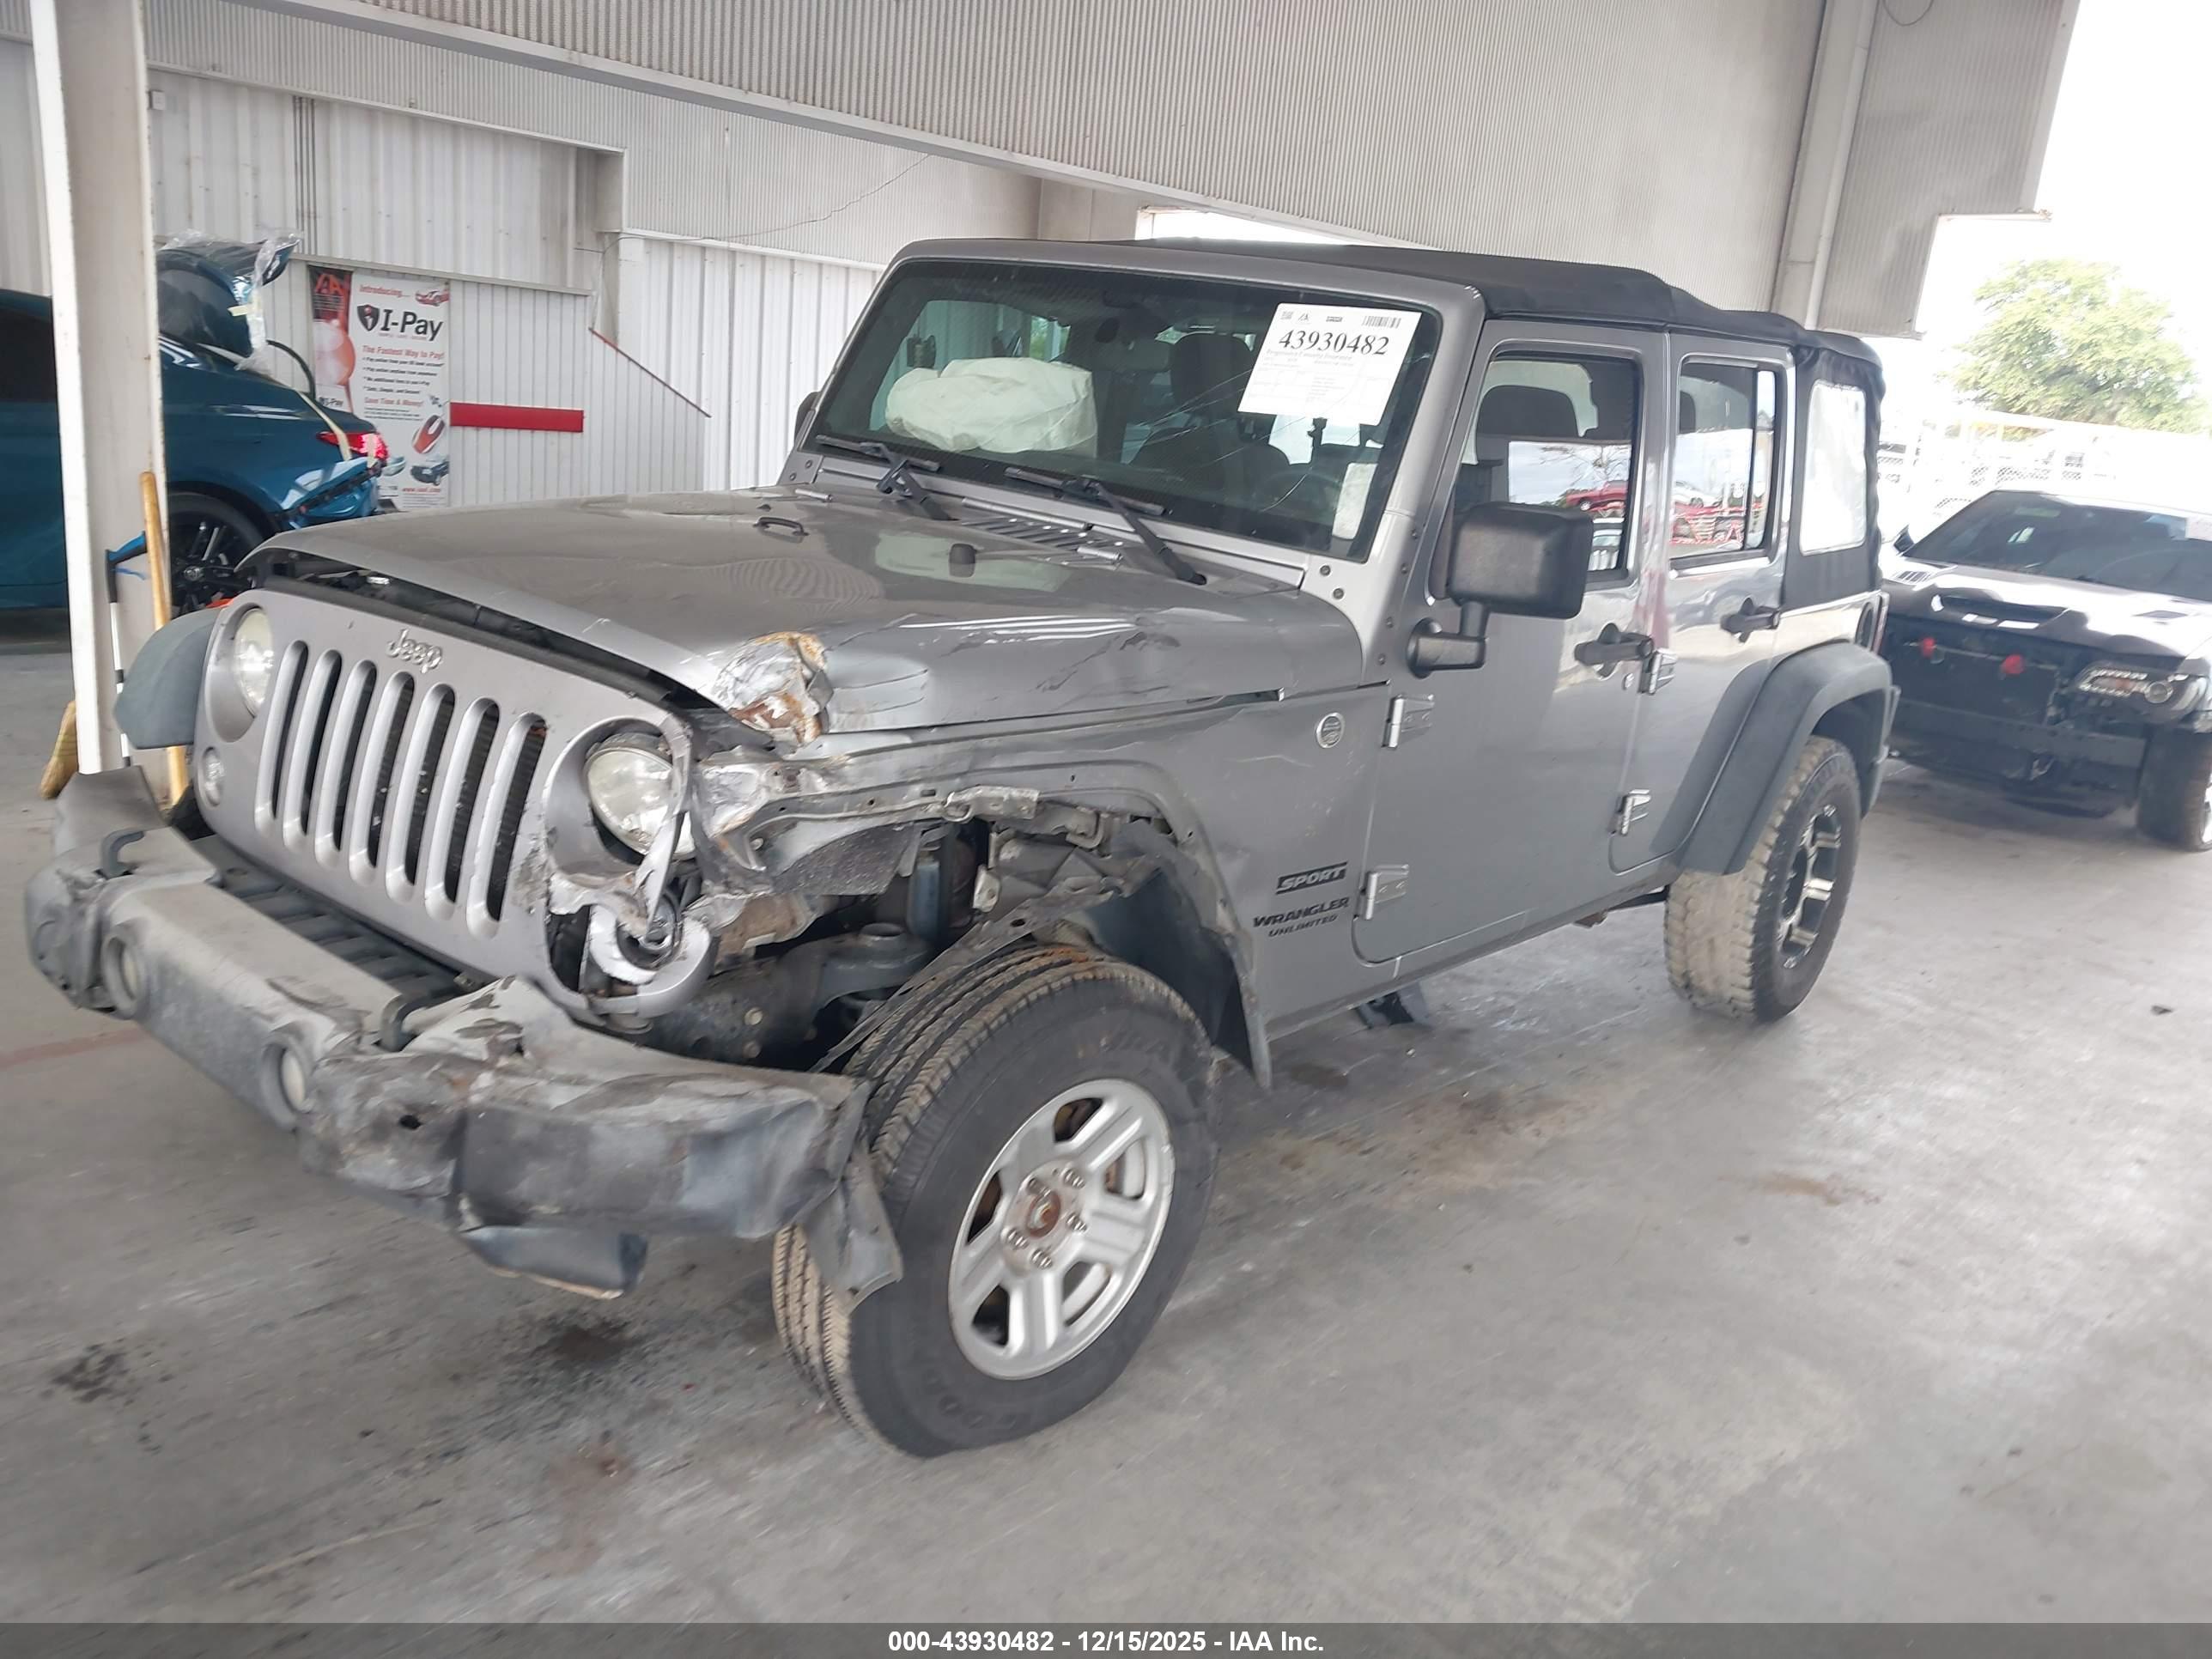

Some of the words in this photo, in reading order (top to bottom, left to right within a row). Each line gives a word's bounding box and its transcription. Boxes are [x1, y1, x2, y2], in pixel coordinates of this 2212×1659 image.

[380, 308, 444, 341] I-Pay
[362, 345, 375, 354] The
[378, 347, 403, 356] Fastest
[404, 349, 419, 359] Way
[1279, 330, 1389, 356] 43930482
[386, 629, 444, 674] Jeep
[1276, 864, 1347, 893] SPORT
[1253, 896, 1350, 927] WRANGLER
[1268, 914, 1339, 937] UNLIMITED
